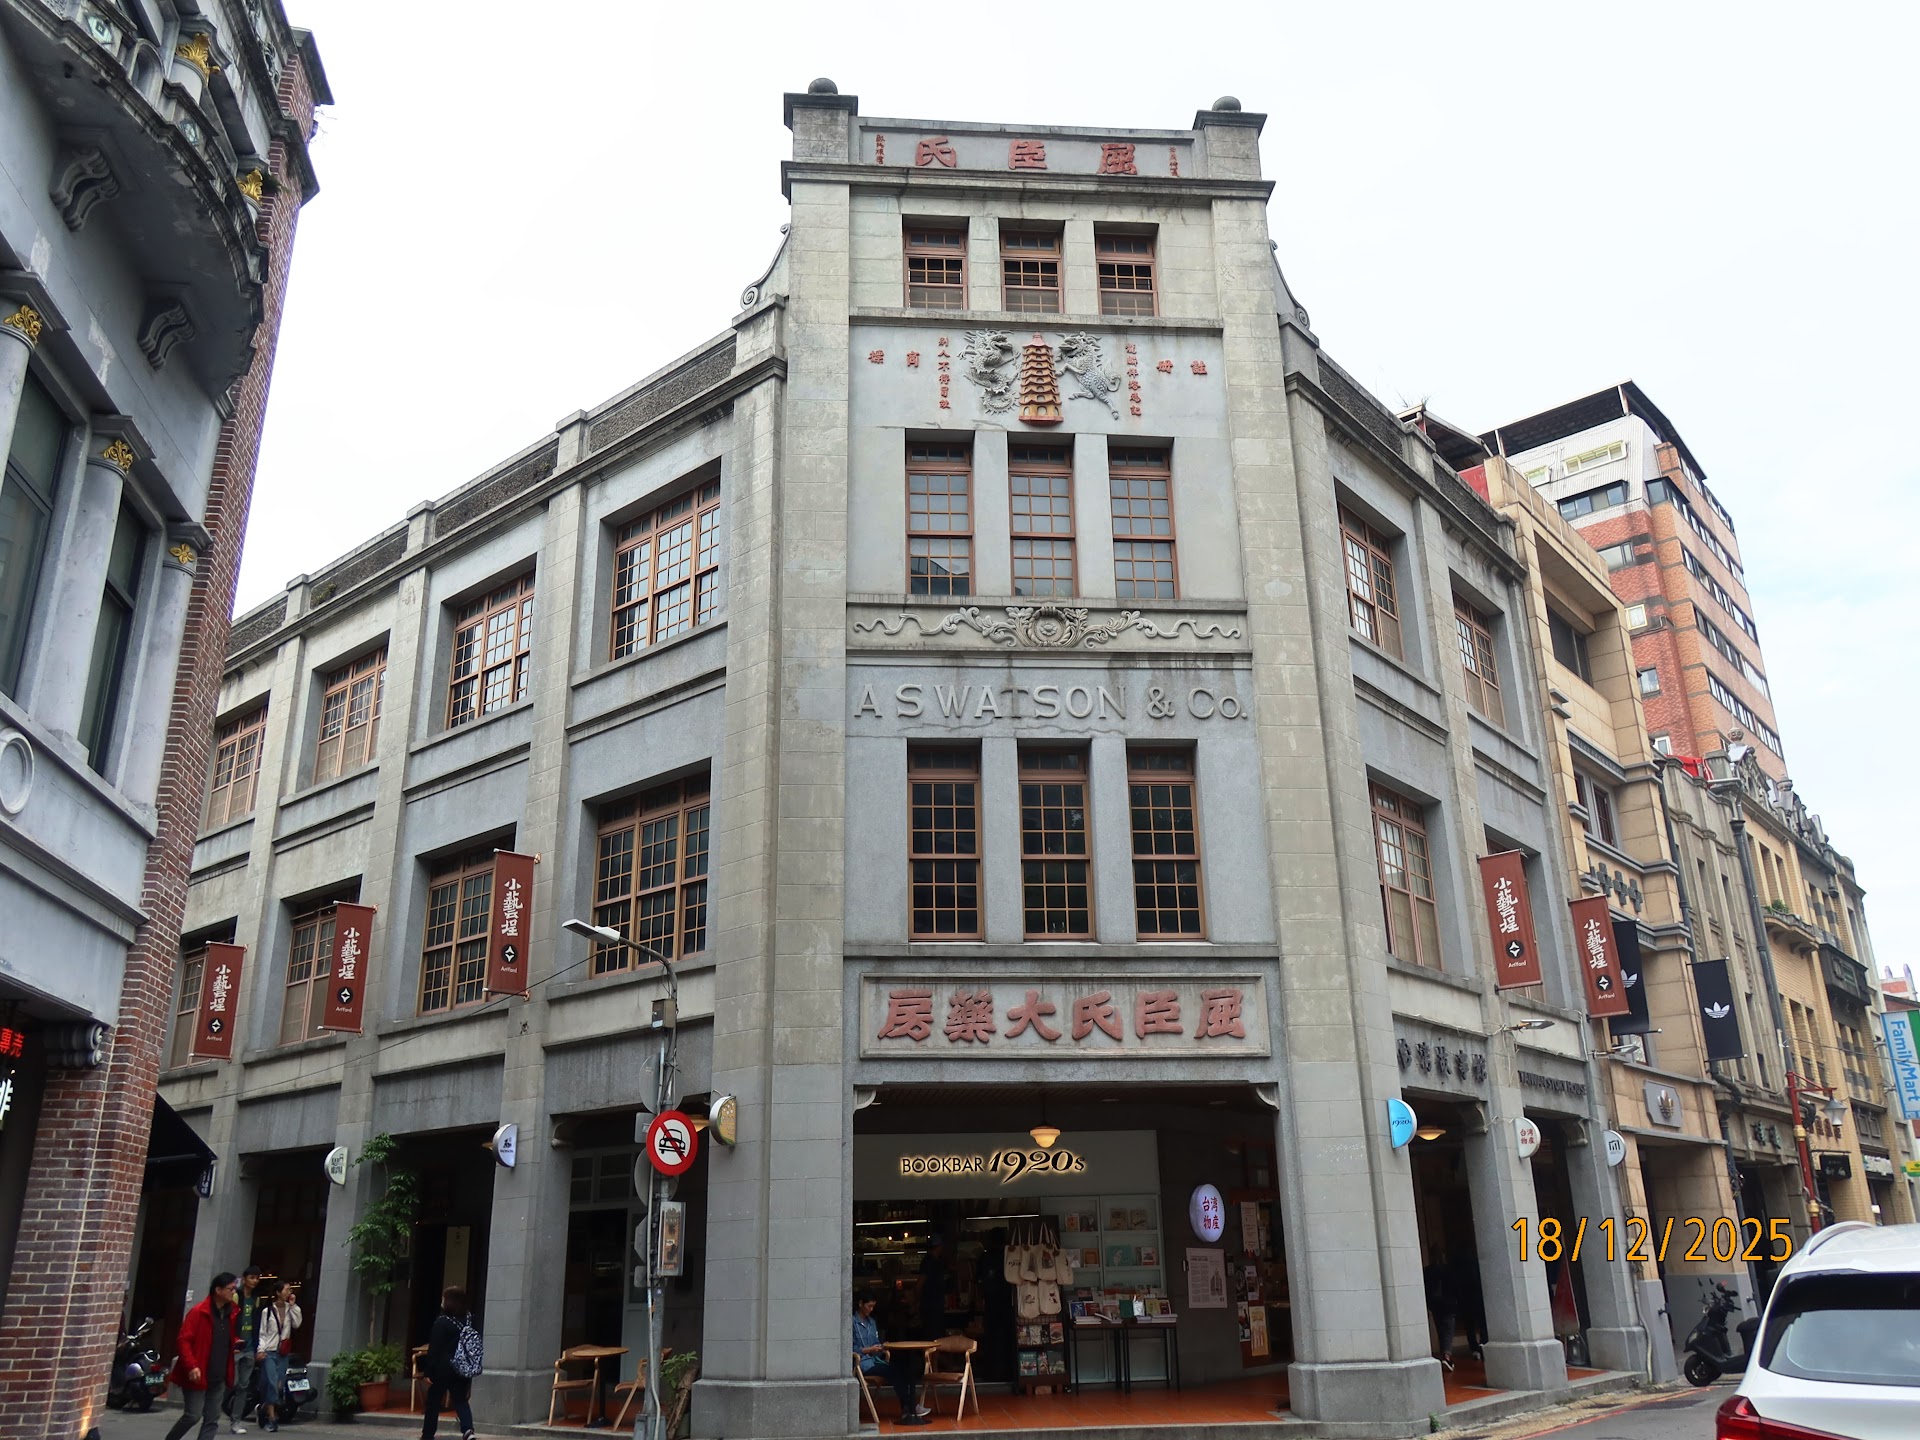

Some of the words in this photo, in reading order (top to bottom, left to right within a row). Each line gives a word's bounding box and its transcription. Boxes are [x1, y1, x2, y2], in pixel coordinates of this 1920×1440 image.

[933, 685, 1126, 720] WATSON
[1147, 686, 1175, 719] &
[501, 878, 523, 936] 小藝埕
[1493, 877, 1519, 934] 小藝埕
[338, 927, 361, 979] 小藝埕
[1584, 919, 1608, 969] 小藝埕
[209, 964, 231, 1012] 小藝埕
[1890, 1020, 1919, 1102] FamilyMart
[903, 1157, 983, 1174] BOOKBAR
[990, 1150, 1085, 1184] 1920s
